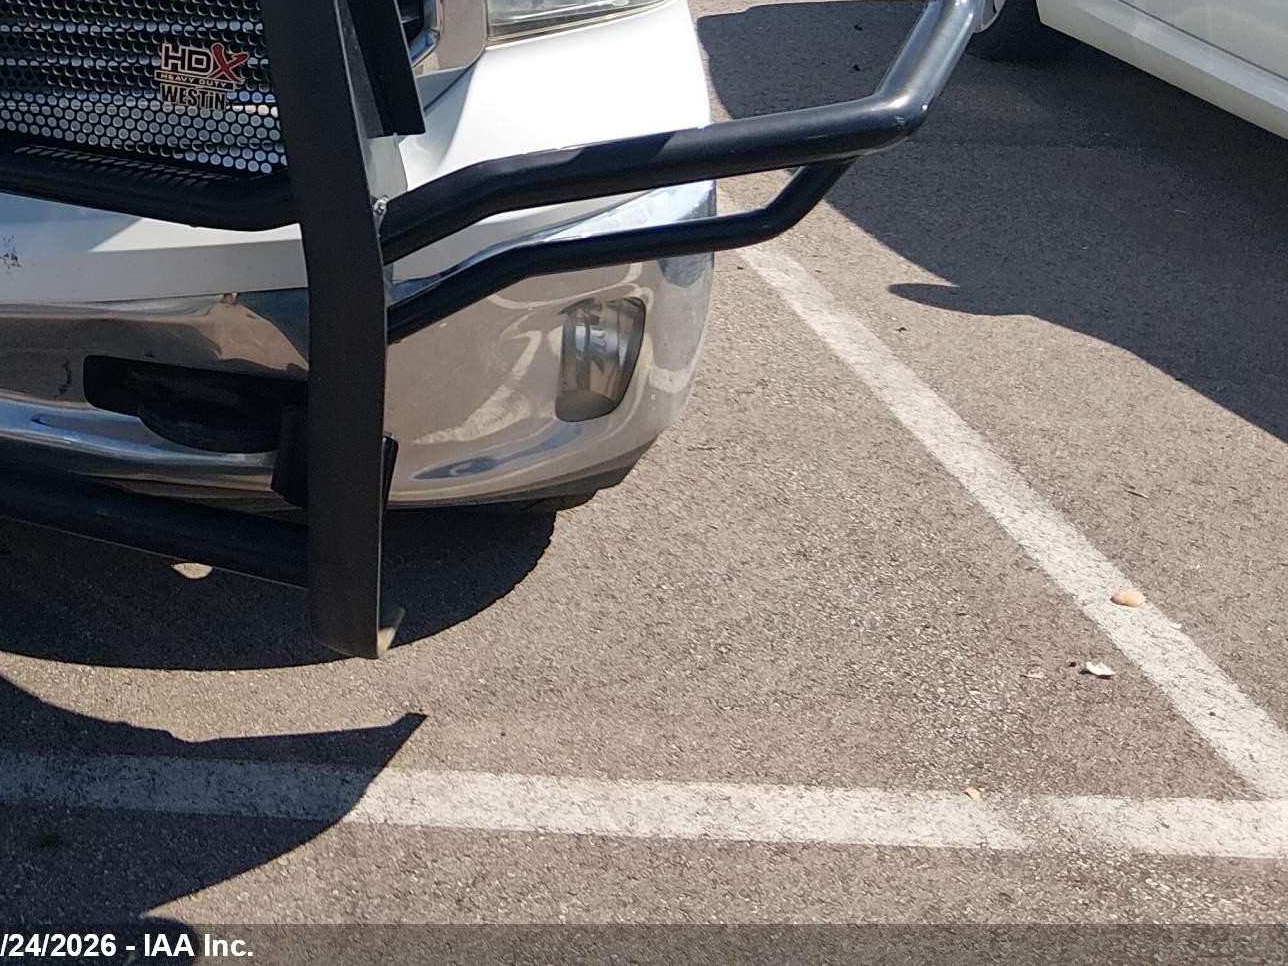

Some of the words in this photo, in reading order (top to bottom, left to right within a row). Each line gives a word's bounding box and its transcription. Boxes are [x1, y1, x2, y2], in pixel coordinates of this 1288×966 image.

[161, 42, 249, 84] HDX
[160, 73, 194, 83] HEAVY
[198, 78, 227, 88] DUTY
